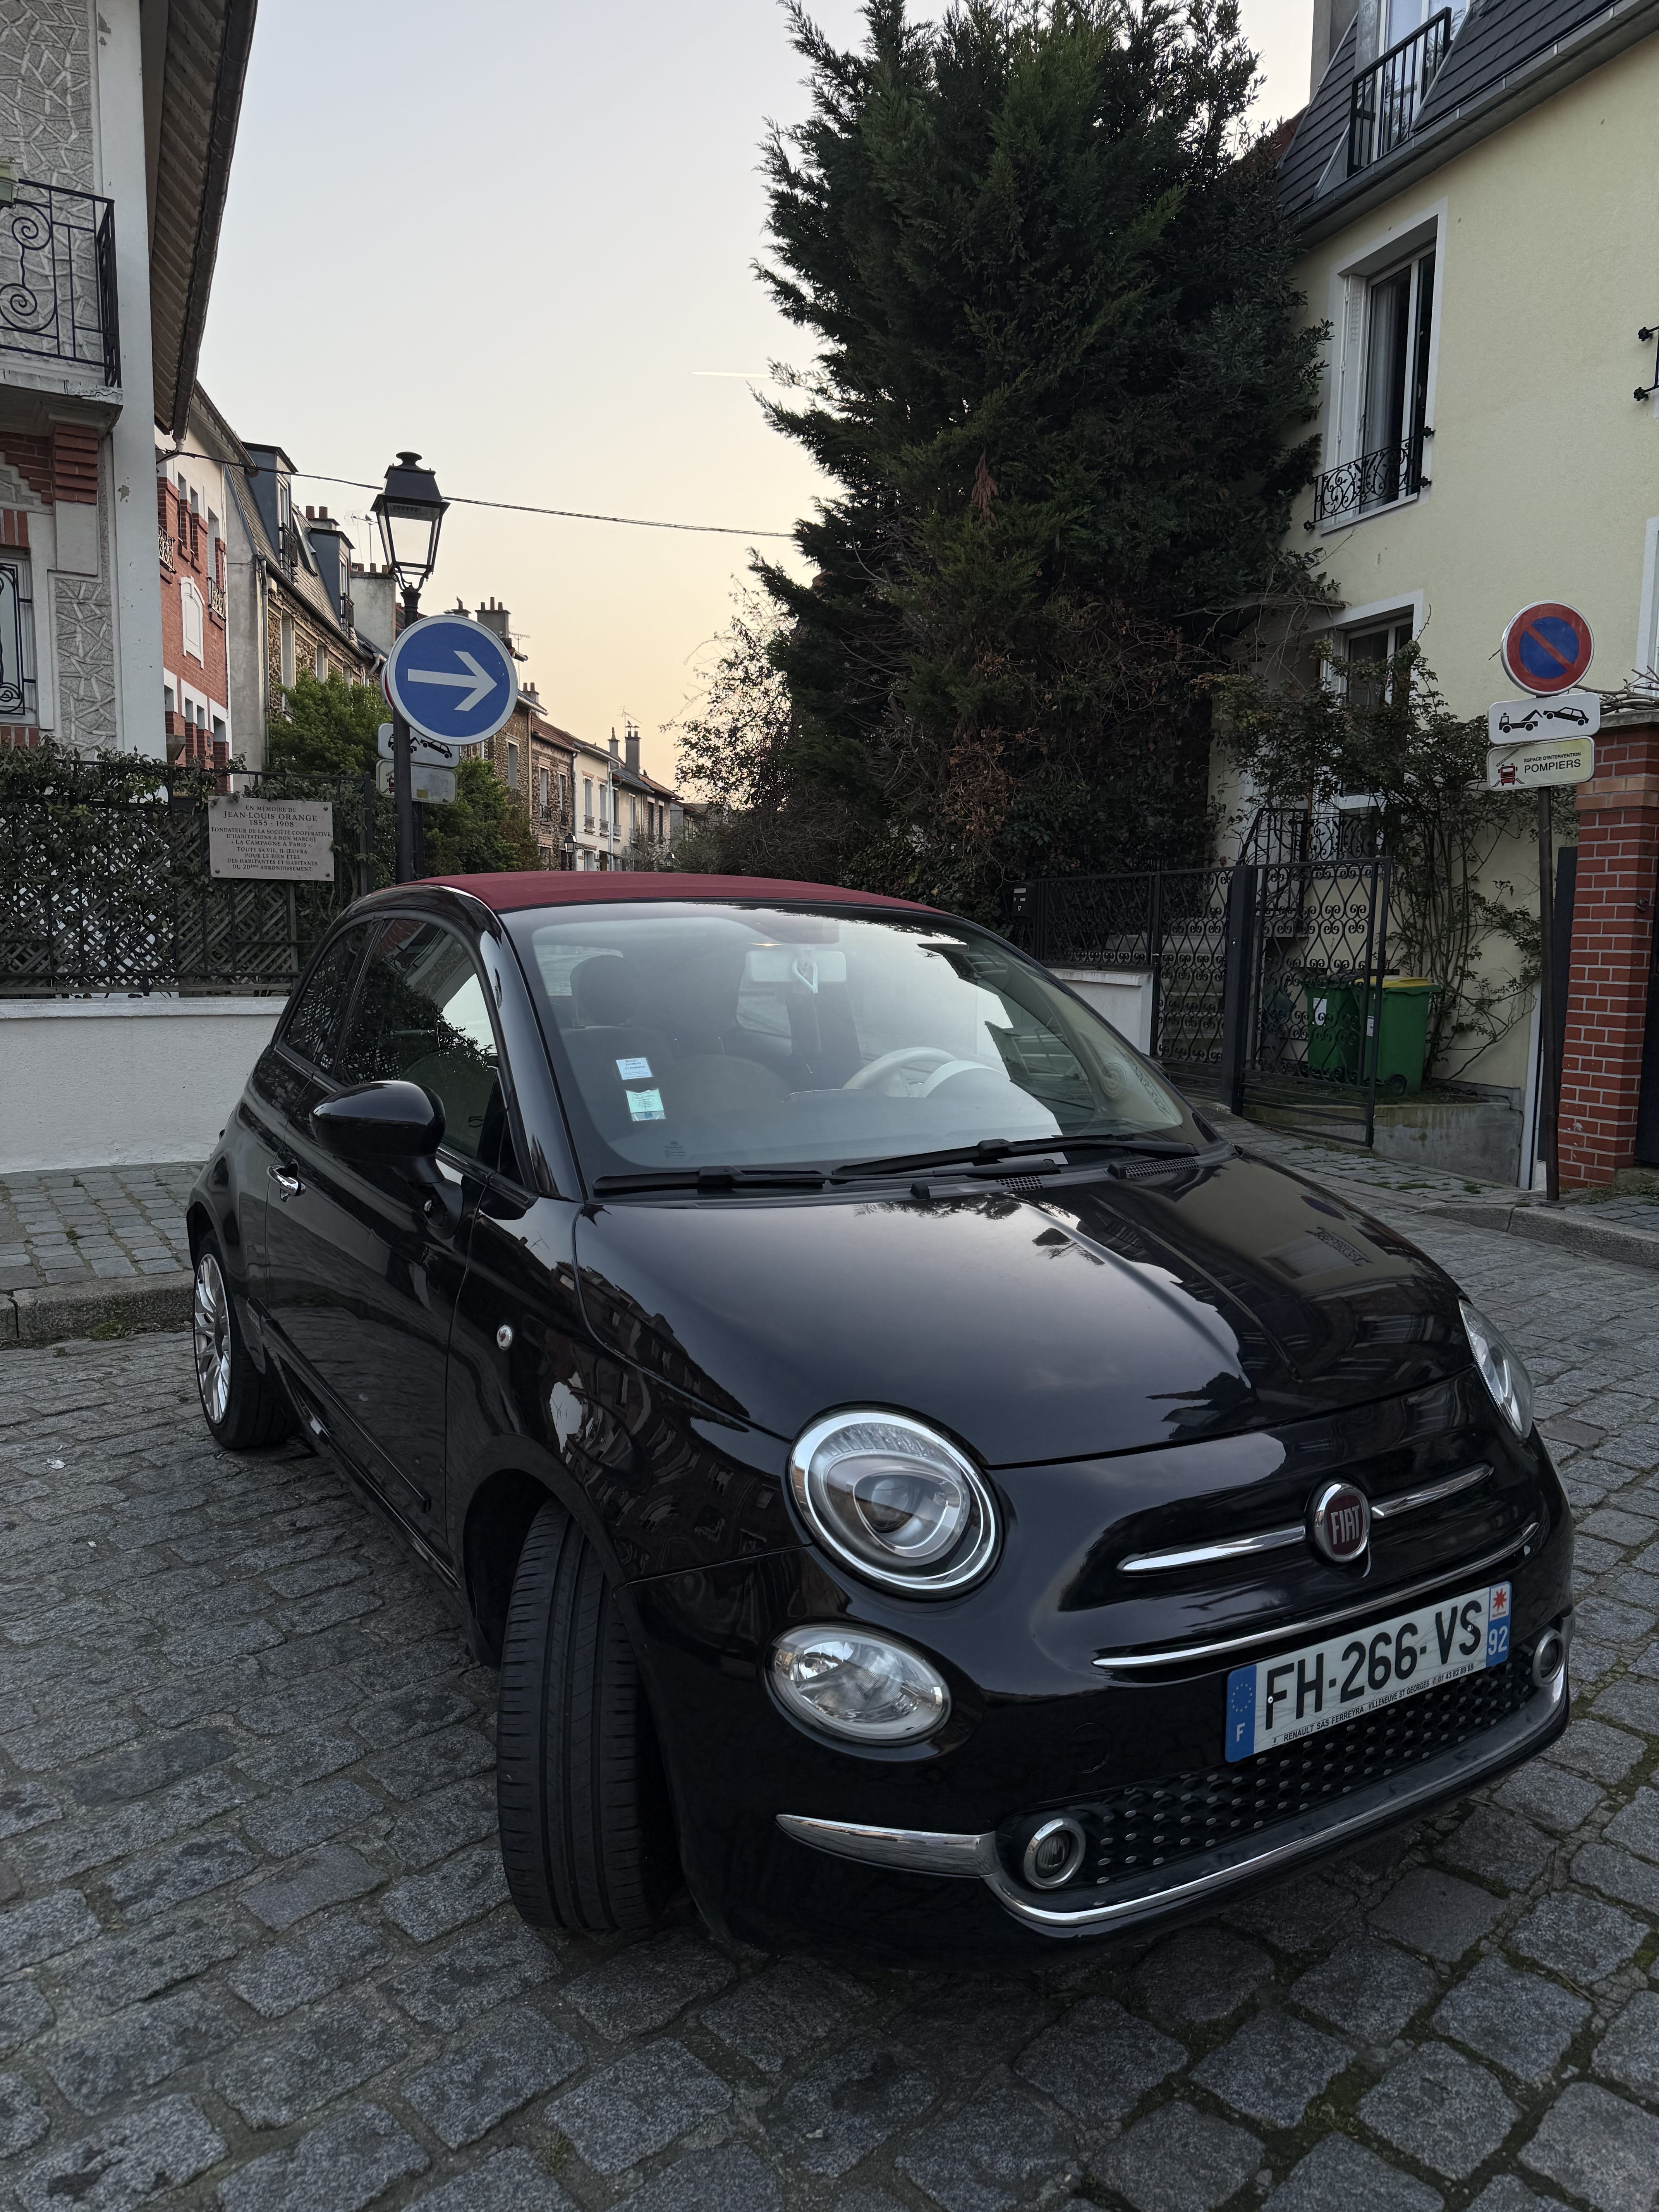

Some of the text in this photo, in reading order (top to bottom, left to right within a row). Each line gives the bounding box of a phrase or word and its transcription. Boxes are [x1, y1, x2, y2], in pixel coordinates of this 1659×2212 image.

[1524, 759, 1581, 773] POMPIERS
[1543, 752, 1581, 761] D'INTERVENTION
[223, 811, 275, 819] JEAN-LOUIS
[1331, 1505, 1360, 1545] FIAT
[1488, 1625, 1508, 1656] 92
[1266, 1600, 1482, 1730] FH-266-VS
[1284, 1724, 1314, 1742] RENAULT
[1316, 1719, 1329, 1730] SAS
[1331, 1706, 1364, 1724] FERREYRA
[1368, 1693, 1398, 1710] VILLENEUVE
[1399, 1689, 1405, 1698] ST
[1407, 1680, 1430, 1695] GEORGES
[1453, 1669, 1459, 1677] 82
[1236, 1723, 1245, 1742] F
